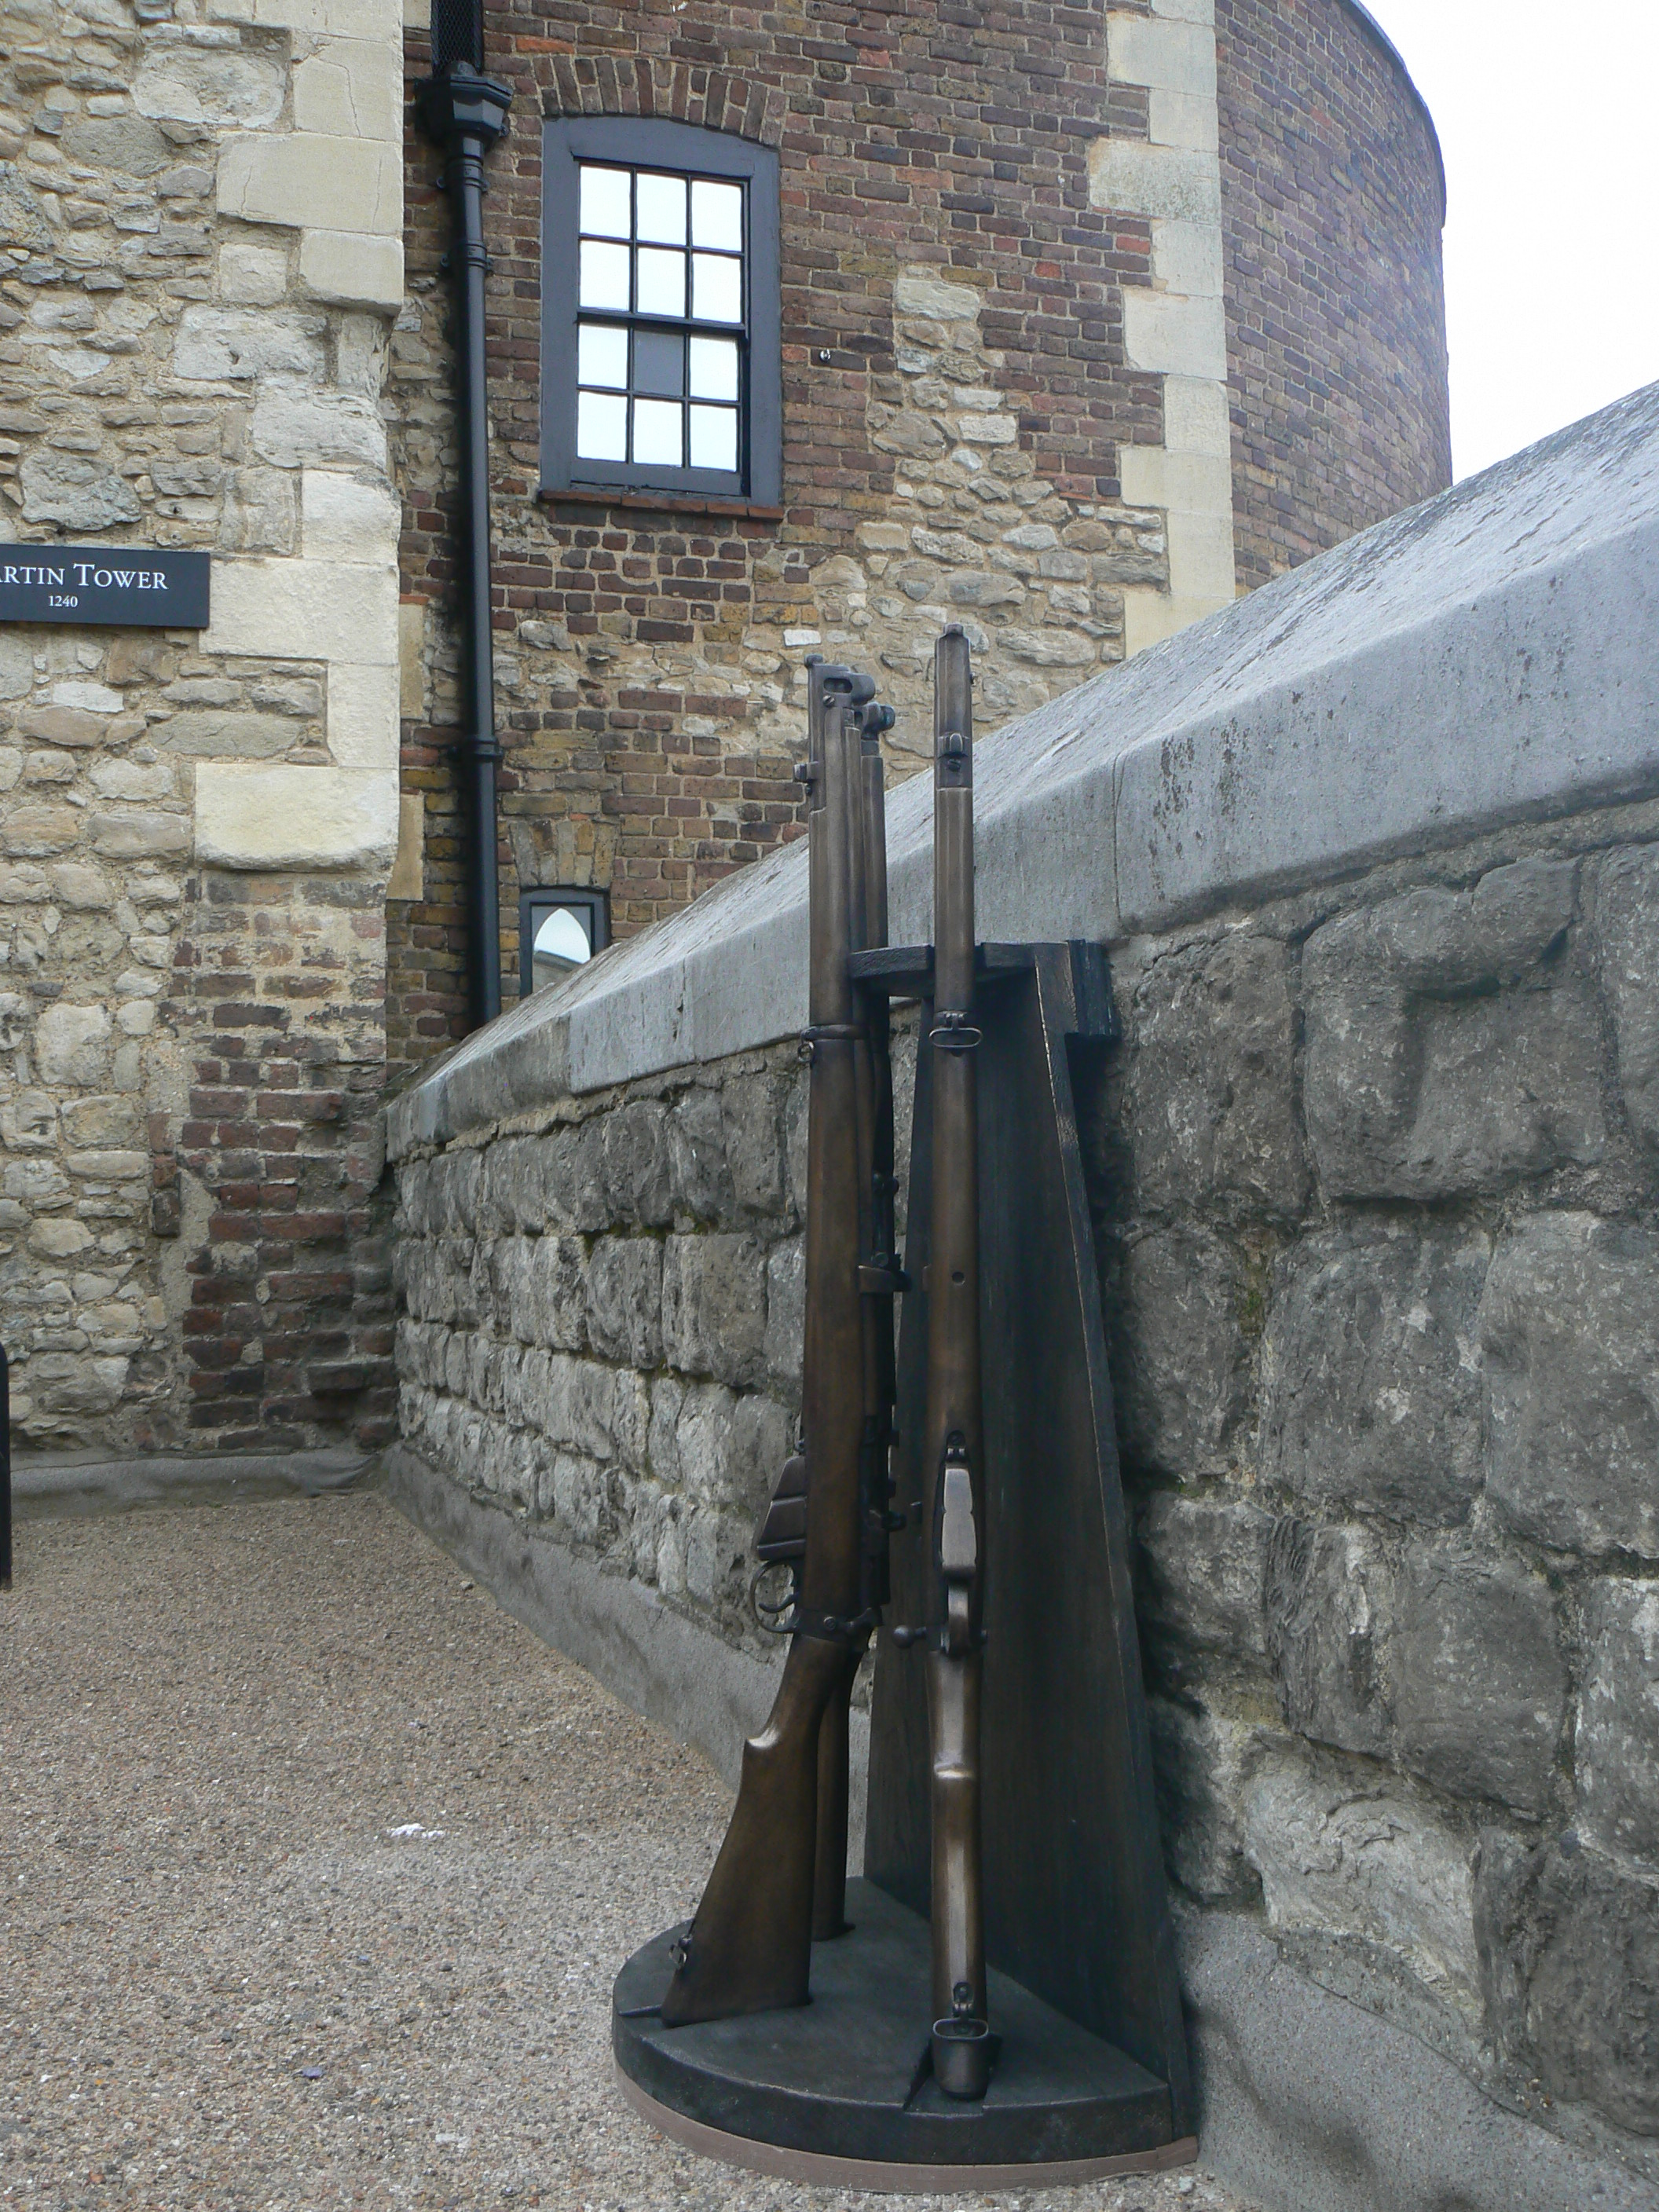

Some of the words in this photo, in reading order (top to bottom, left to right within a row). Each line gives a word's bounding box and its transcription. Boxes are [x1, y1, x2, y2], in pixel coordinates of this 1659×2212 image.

[0, 566, 65, 585] RTIN
[72, 563, 169, 590] TOWER
[48, 595, 79, 608] 1240
